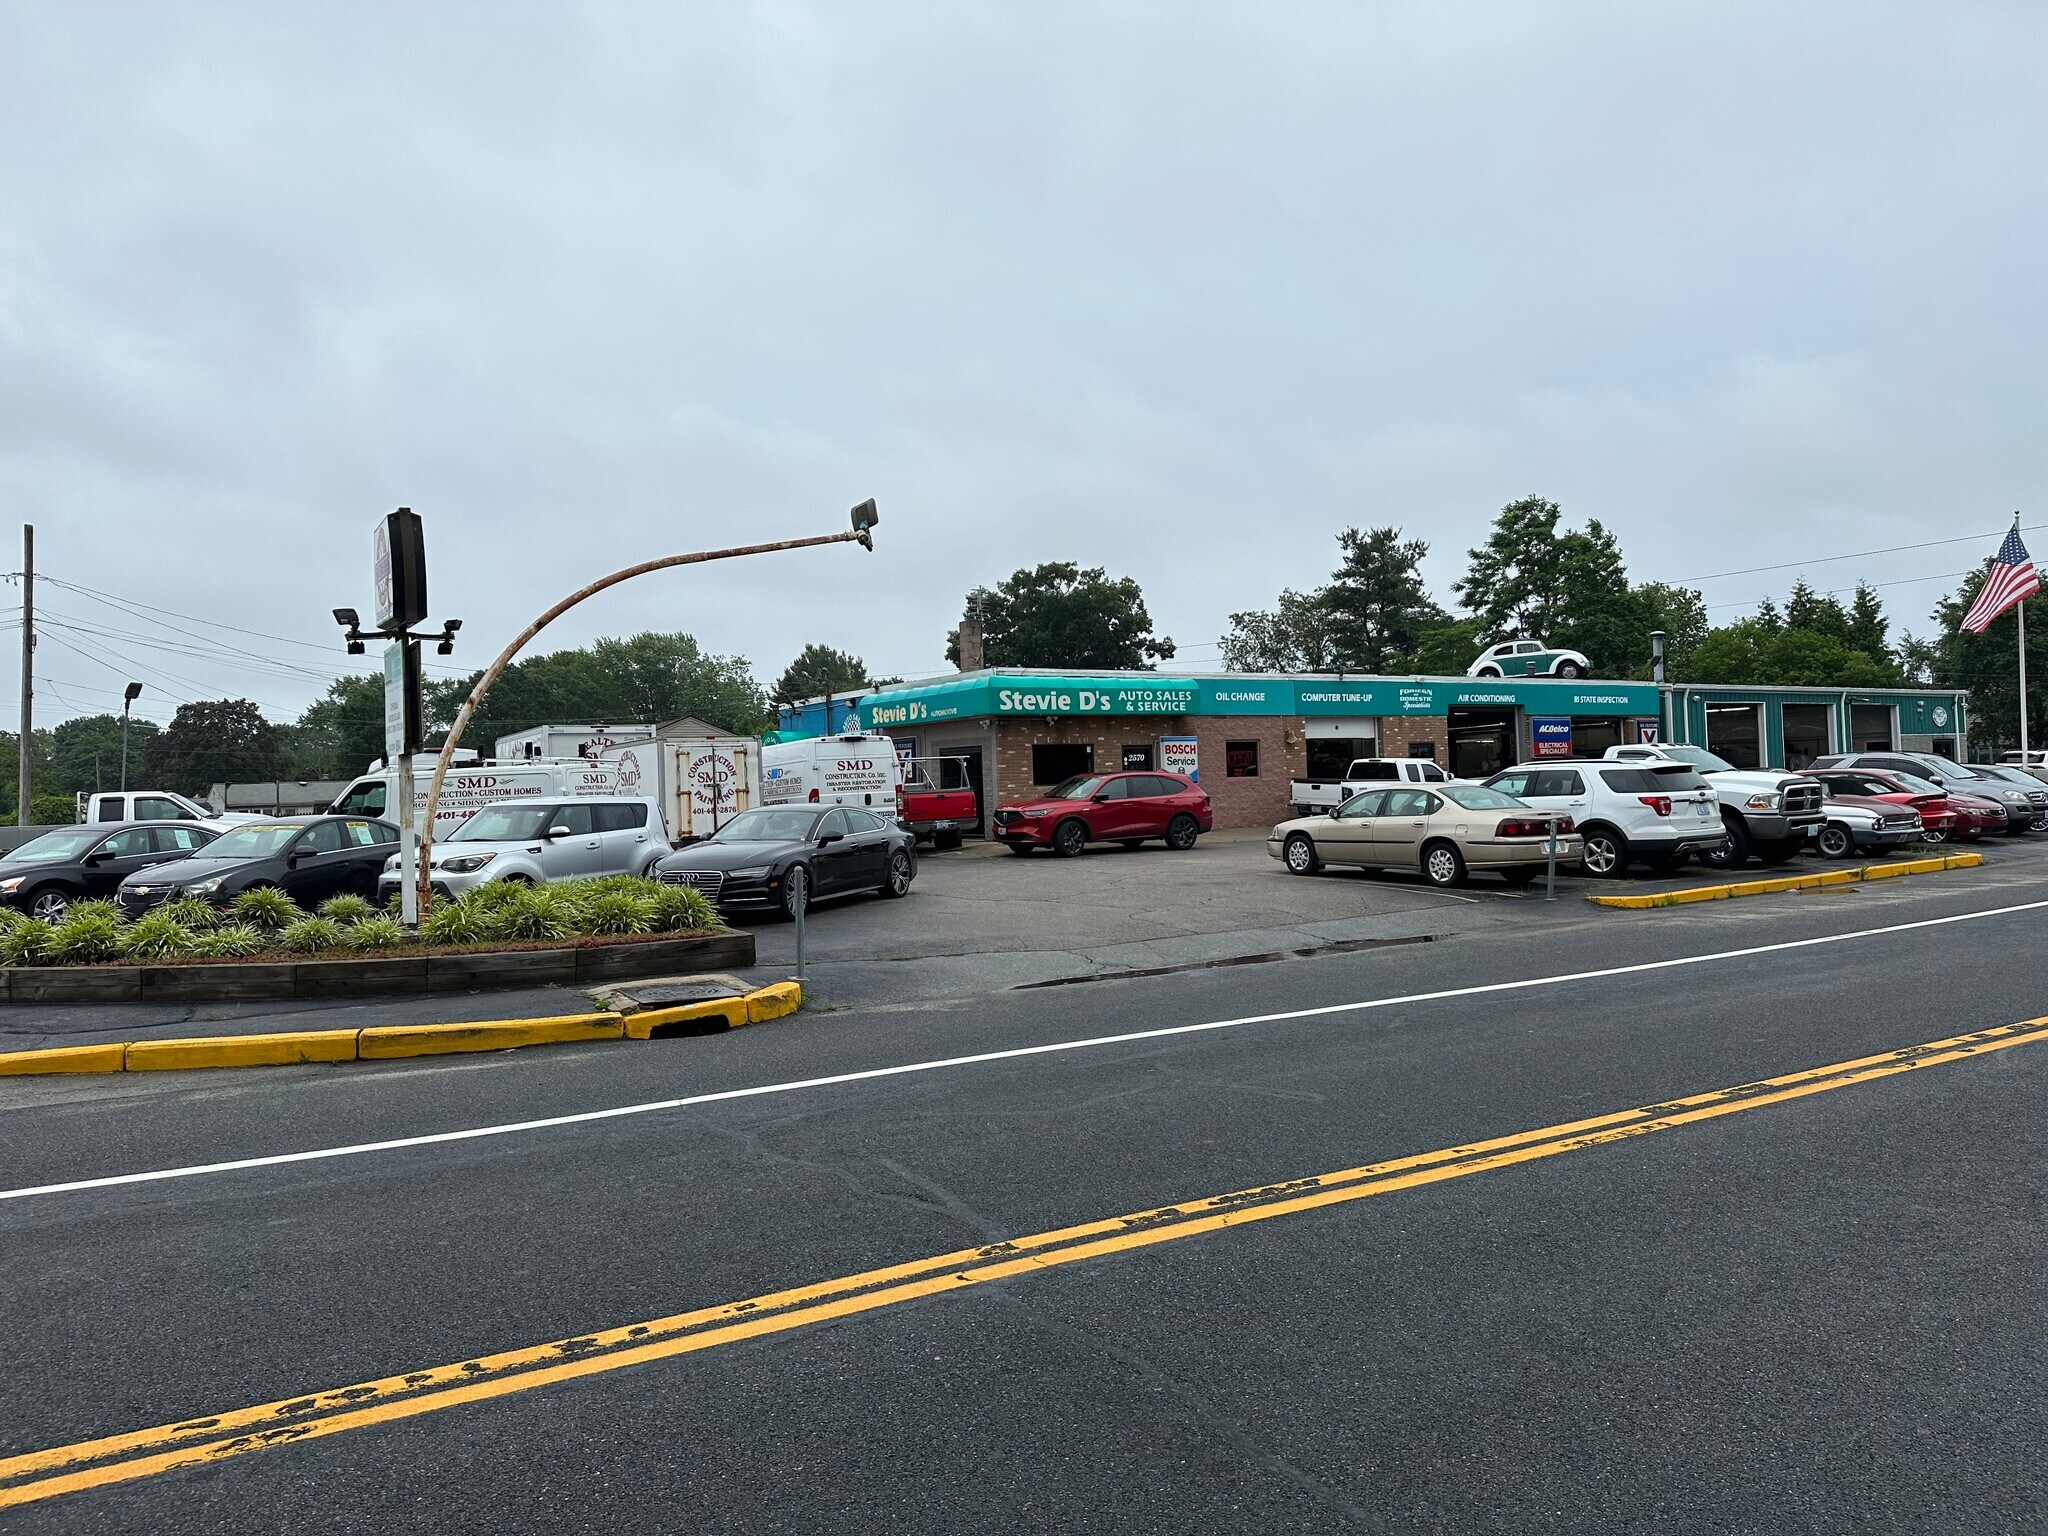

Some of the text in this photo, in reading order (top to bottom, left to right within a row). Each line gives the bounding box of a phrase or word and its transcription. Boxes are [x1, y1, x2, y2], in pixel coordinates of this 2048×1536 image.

[1000, 690, 1111, 711] Stevie D's
[1118, 691, 1192, 701] AUTO SALES
[1215, 692, 1265, 701] OIL CHANGE
[1301, 693, 1373, 702] COMPUTER TUNE-UP
[1457, 694, 1516, 703] AIR CONDITIONING
[1597, 696, 1629, 704] INSPECTION
[1126, 701, 1186, 711] & SERVICE
[872, 704, 907, 724] Stevie
[909, 701, 928, 720] D's
[1539, 724, 1569, 733] ACDelco
[1164, 744, 1197, 755] BOSCH
[1538, 741, 1569, 749] ELECTRICAL
[1128, 754, 1145, 762] 2570
[1166, 756, 1196, 766] Service
[688, 754, 737, 778] CONSTRUCTION
[837, 760, 873, 771] SMD
[457, 776, 497, 789] SMD
[582, 774, 608, 784] SMD
[621, 771, 637, 787] SMD
[697, 771, 729, 784] SMD
[414, 786, 542, 800] CONRUCTION CUSTOM HOMES
[457, 799, 486, 807] SIDING
[692, 806, 737, 815] 401-48-2876
